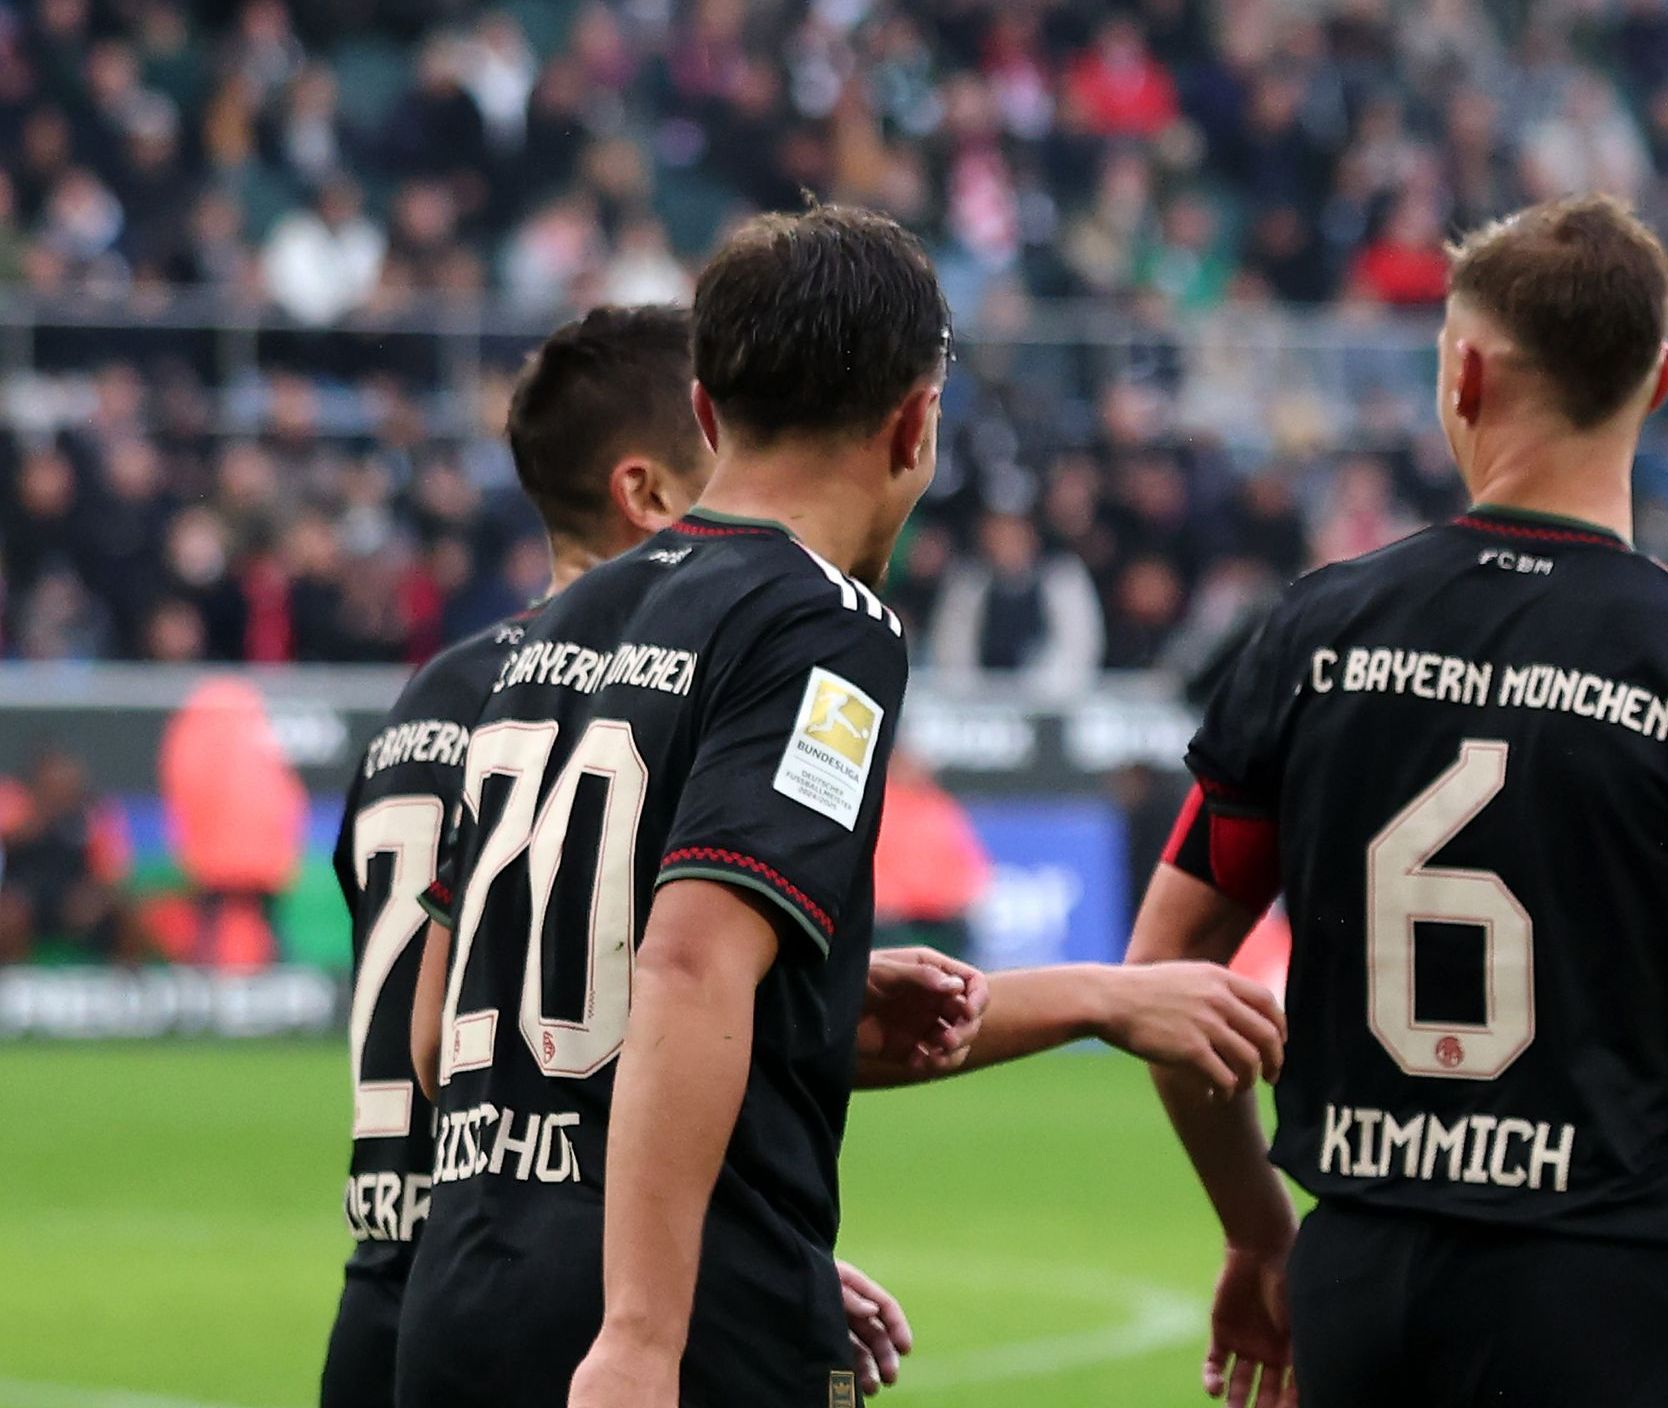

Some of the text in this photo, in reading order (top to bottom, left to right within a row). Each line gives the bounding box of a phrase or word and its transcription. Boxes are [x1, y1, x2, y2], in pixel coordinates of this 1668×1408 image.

[797, 740, 860, 784] BUNDESLIGA
[1296, 648, 1339, 695] C
[1342, 647, 1494, 707] BAYERN
[350, 793, 462, 1140] 2
[438, 718, 649, 1086] 20
[1366, 738, 1536, 1081] 6
[1319, 1102, 1577, 1193] KIMMICH
